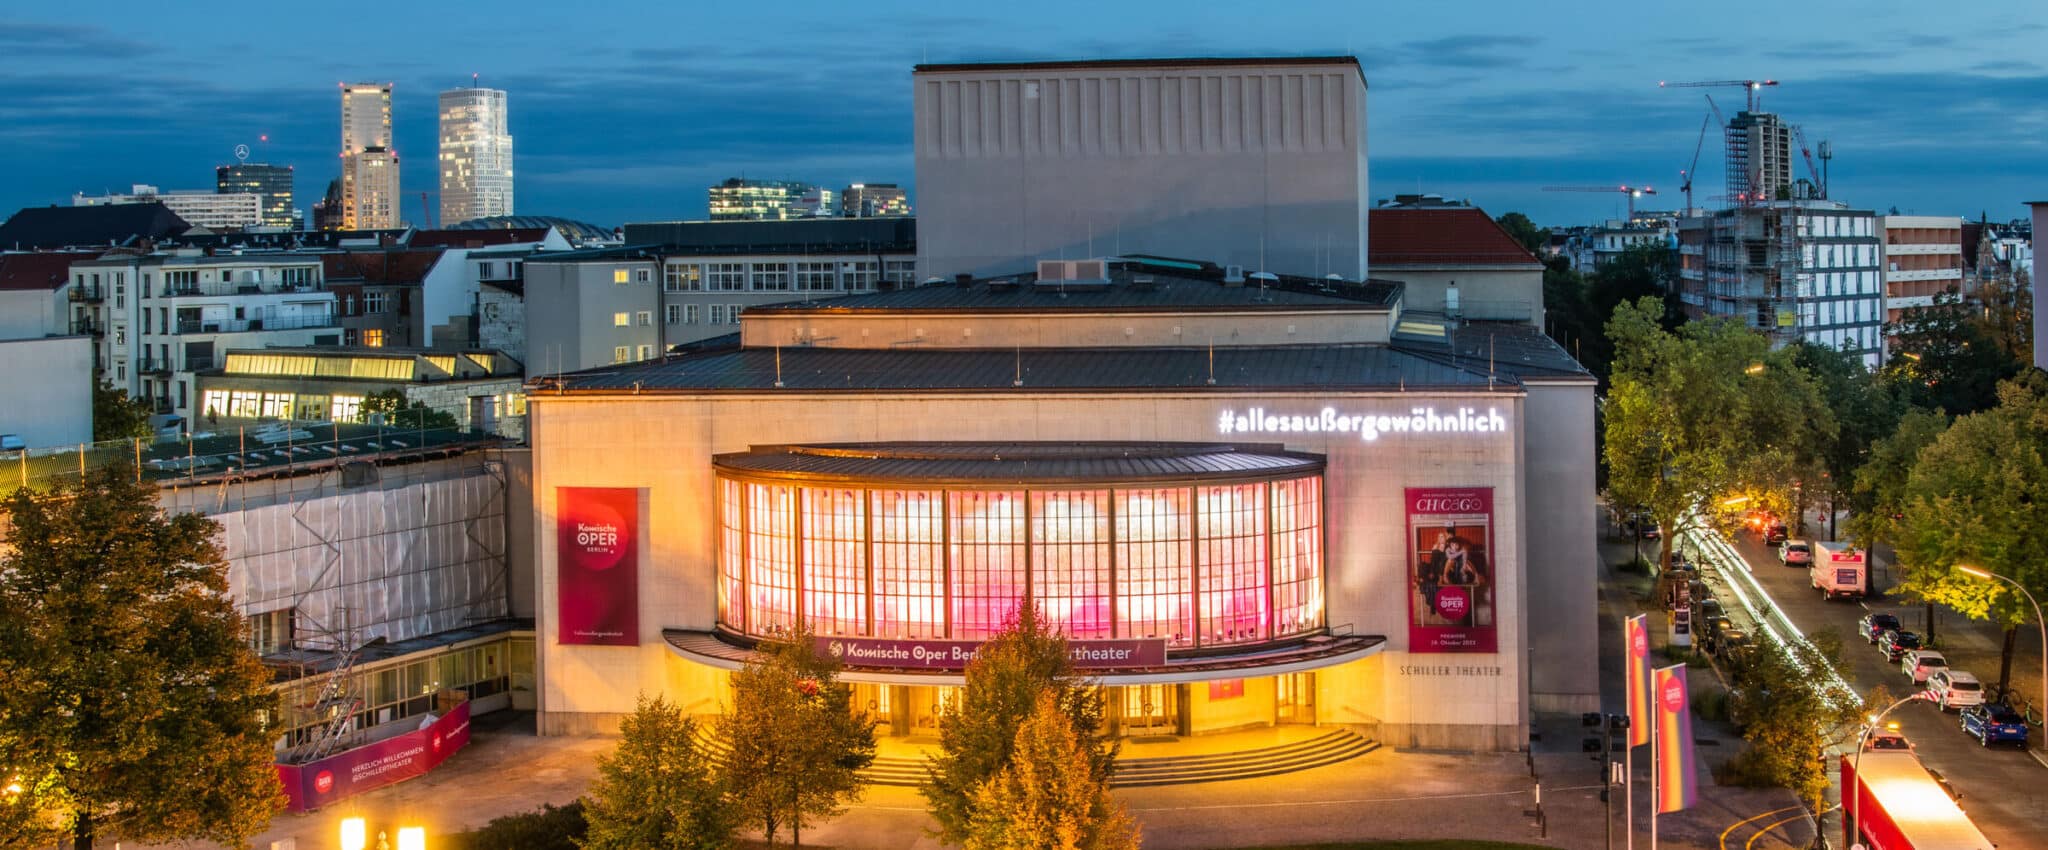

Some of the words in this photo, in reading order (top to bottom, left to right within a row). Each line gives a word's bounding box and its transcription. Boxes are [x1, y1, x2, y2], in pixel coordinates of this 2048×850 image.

[1219, 406, 1505, 441] #allesaußergewöhnlich
[577, 532, 617, 546] OPER
[847, 643, 909, 660] Komische
[912, 645, 948, 665] Oper
[1400, 665, 1450, 676] SCHILLER
[1457, 665, 1501, 676] THEATER
[351, 758, 382, 774] HERZLICH
[383, 746, 424, 764] WILLKOMMEN
